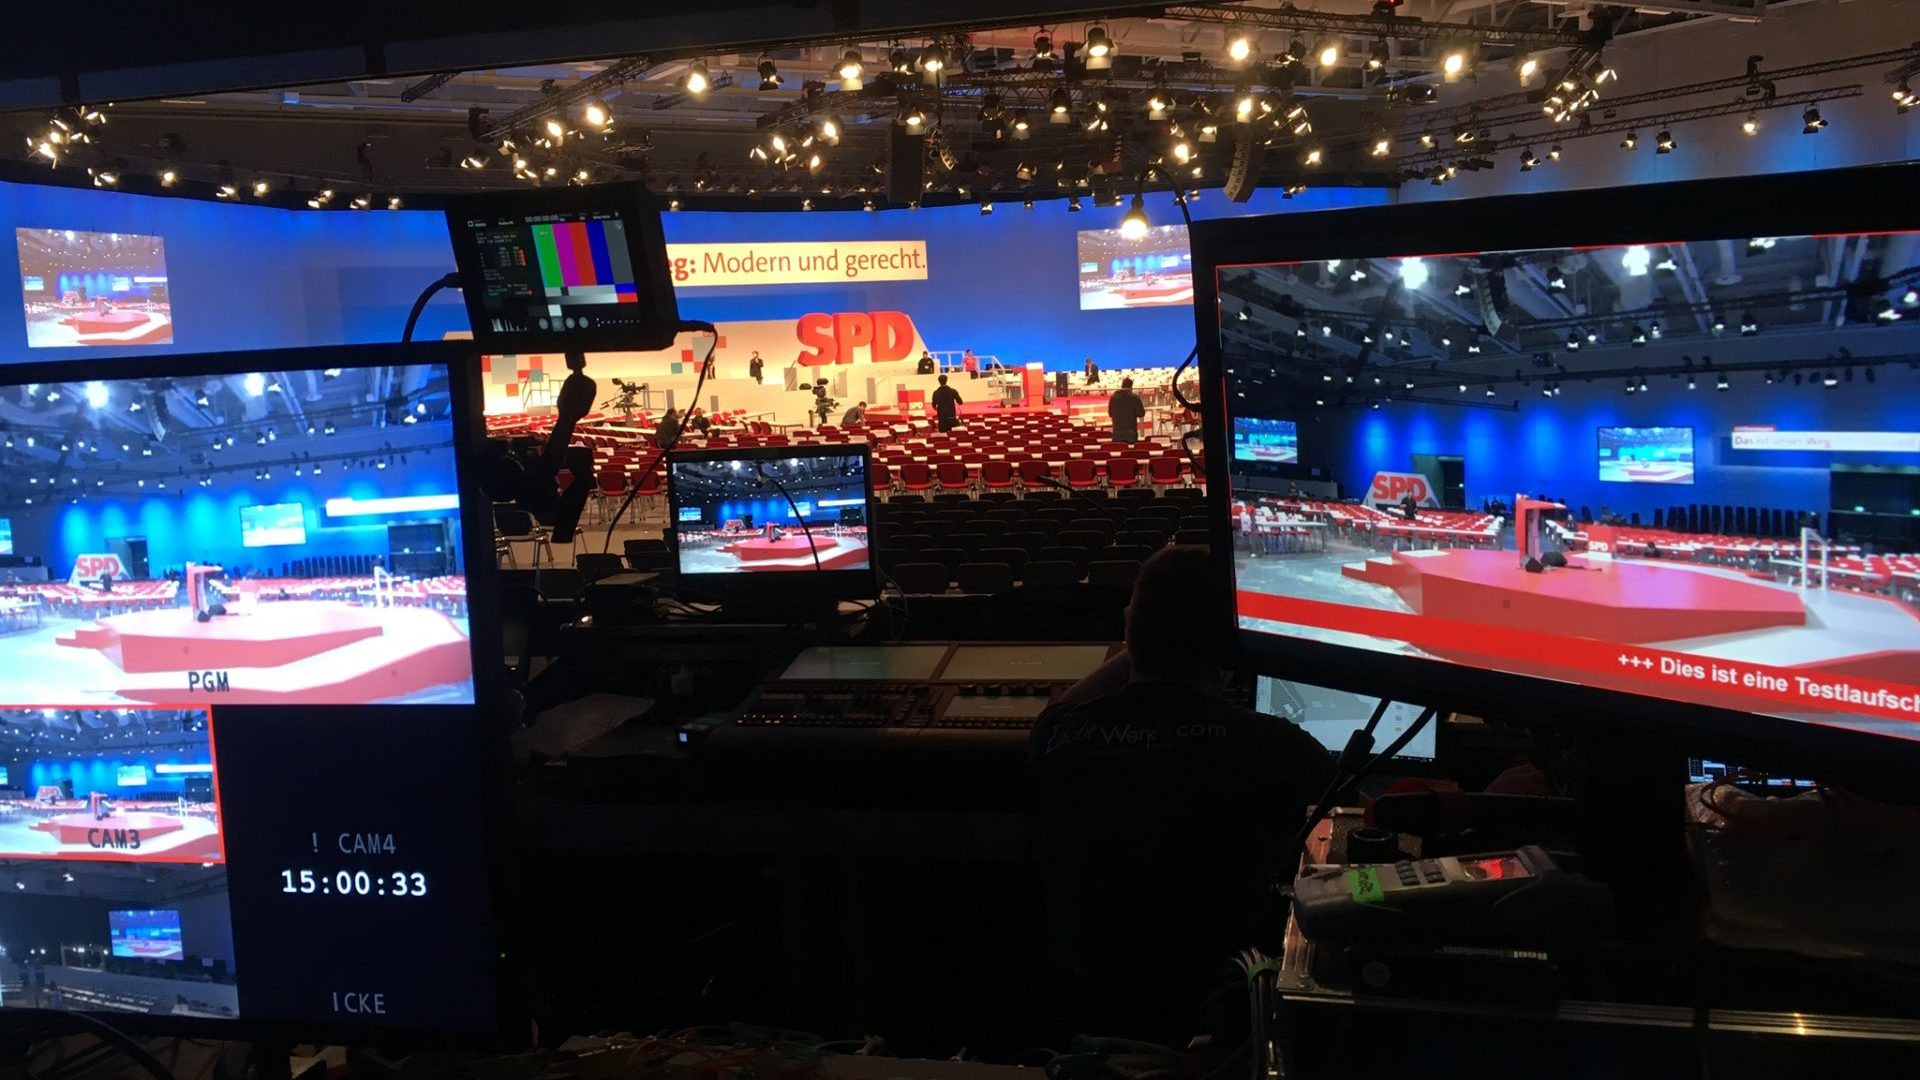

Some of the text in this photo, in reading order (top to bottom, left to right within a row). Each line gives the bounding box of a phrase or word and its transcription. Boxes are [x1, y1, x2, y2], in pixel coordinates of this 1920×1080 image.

[703, 250, 791, 273] Modern
[798, 249, 839, 271] und
[845, 248, 926, 277] gerecht.
[796, 310, 914, 367] SPD
[1373, 475, 1427, 502] SPD
[76, 556, 119, 577] SPD
[188, 671, 230, 692] PGM
[1660, 656, 1705, 679] Dies
[1711, 664, 1738, 685] ist
[1743, 671, 1788, 692] eine
[87, 828, 141, 850] CAM3
[338, 833, 397, 855] CAM4
[281, 869, 427, 897] 15:00:33
[333, 992, 387, 1015] ICKE
